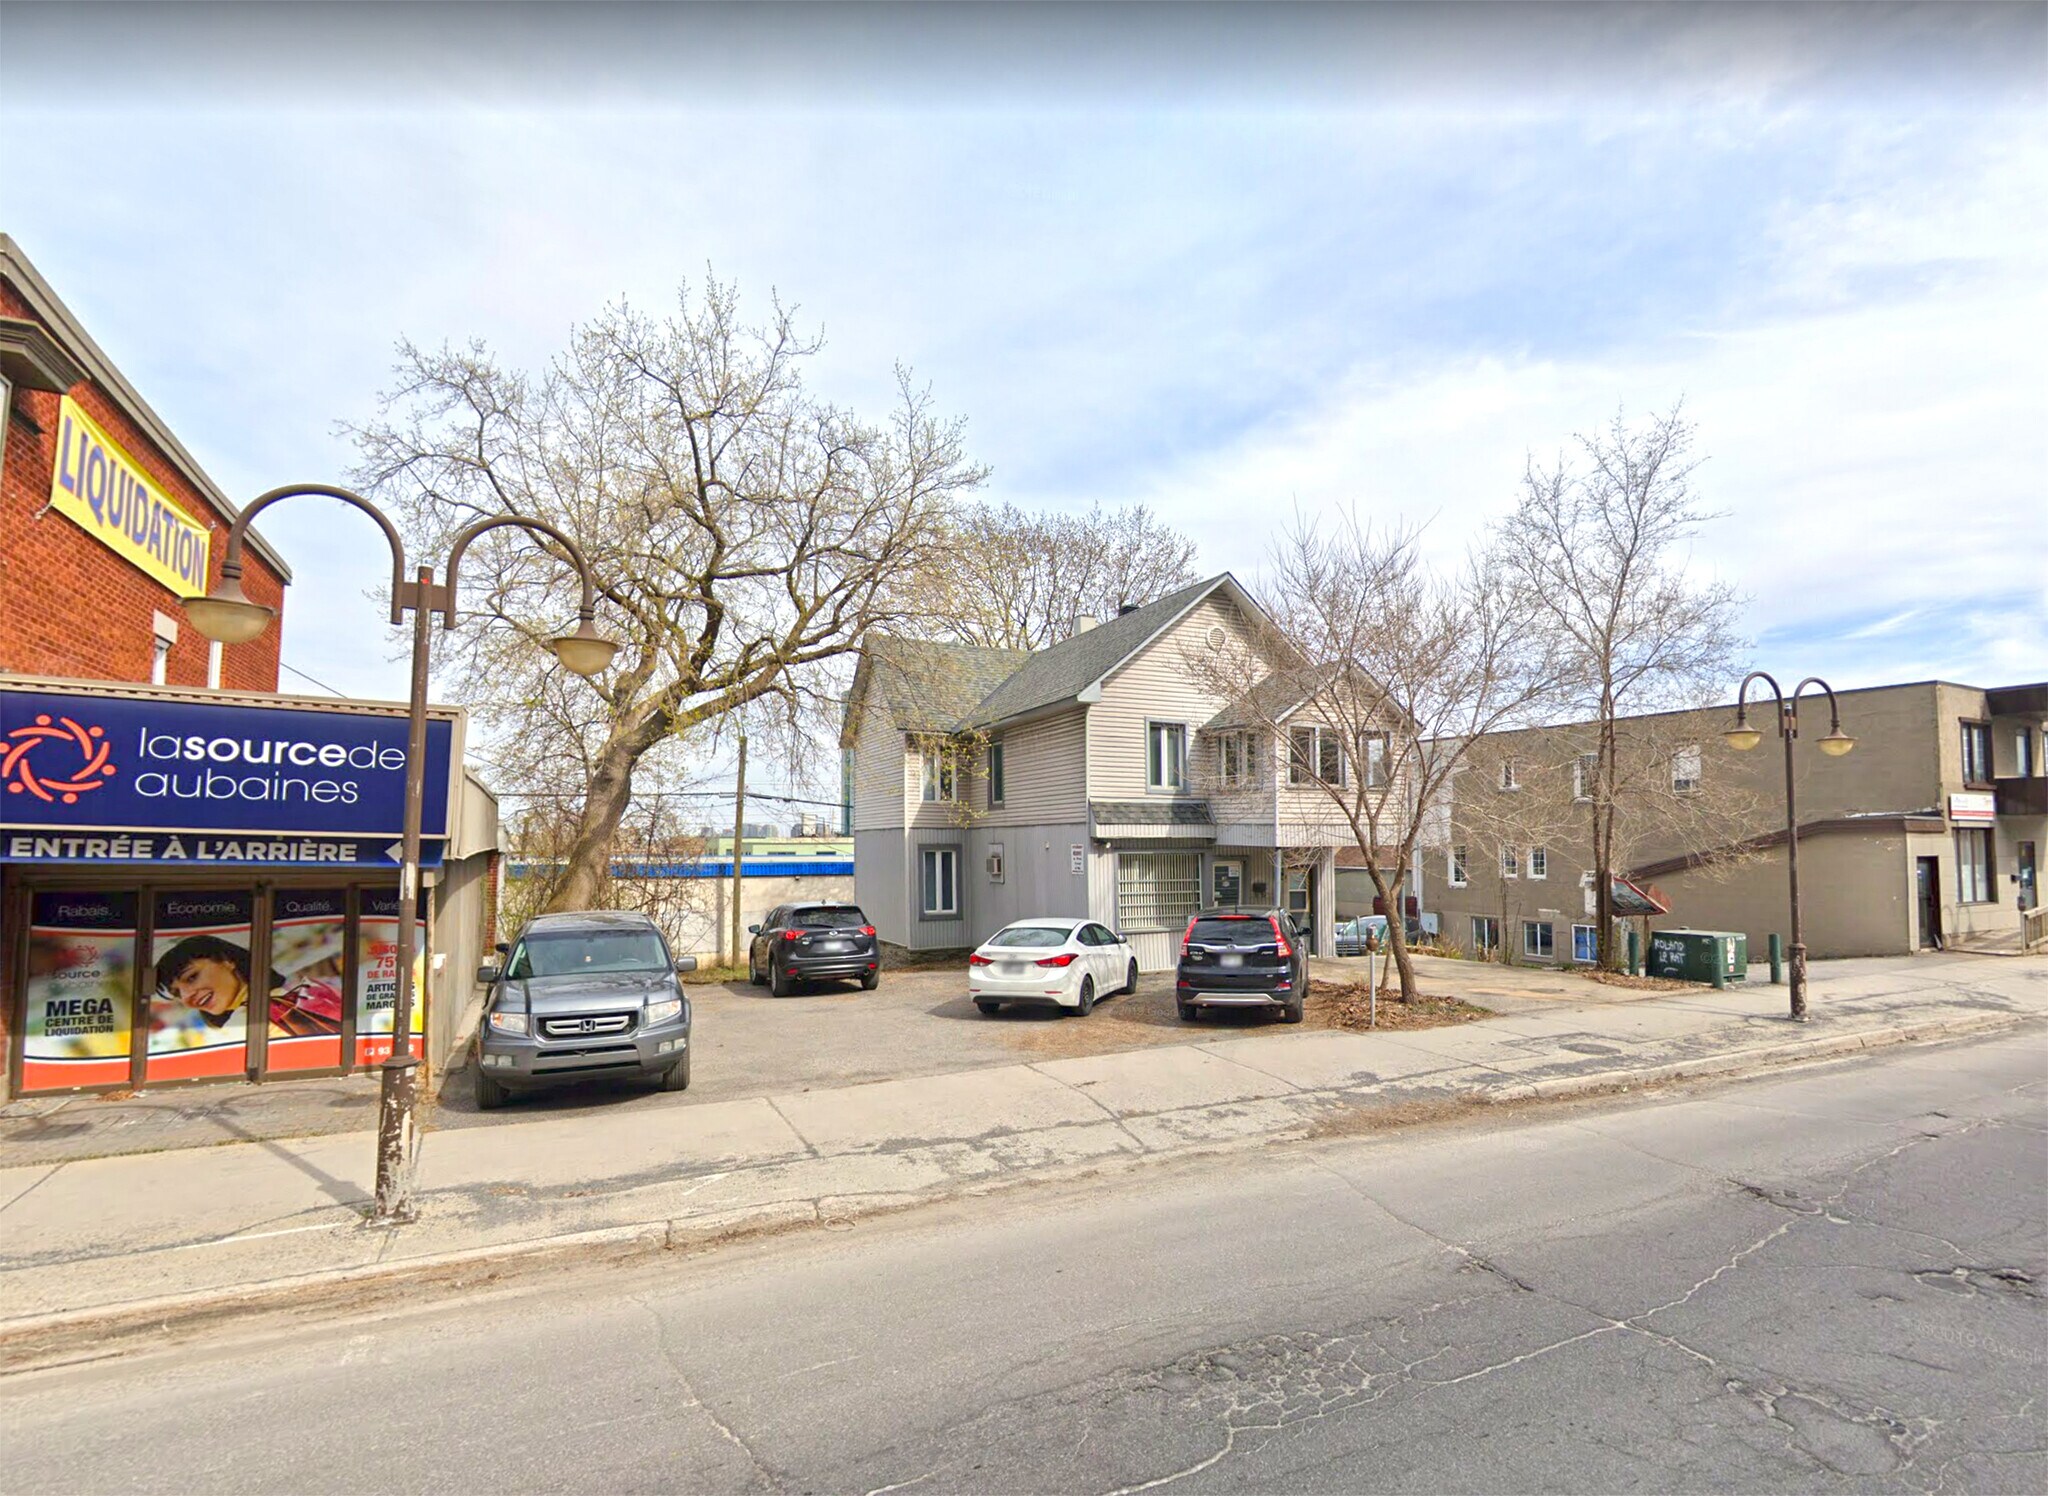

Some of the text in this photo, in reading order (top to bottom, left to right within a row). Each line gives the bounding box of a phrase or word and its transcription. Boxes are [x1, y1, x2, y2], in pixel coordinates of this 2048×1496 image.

[59, 415, 206, 592] LIQUIDATION
[135, 768, 359, 804] aubaines
[9, 835, 153, 859] ENTRÉE
[161, 836, 190, 860] À
[46, 998, 113, 1017] MEGA
[45, 1015, 114, 1027] CENTRE DE
[45, 1026, 113, 1036] LIQUIDATION
